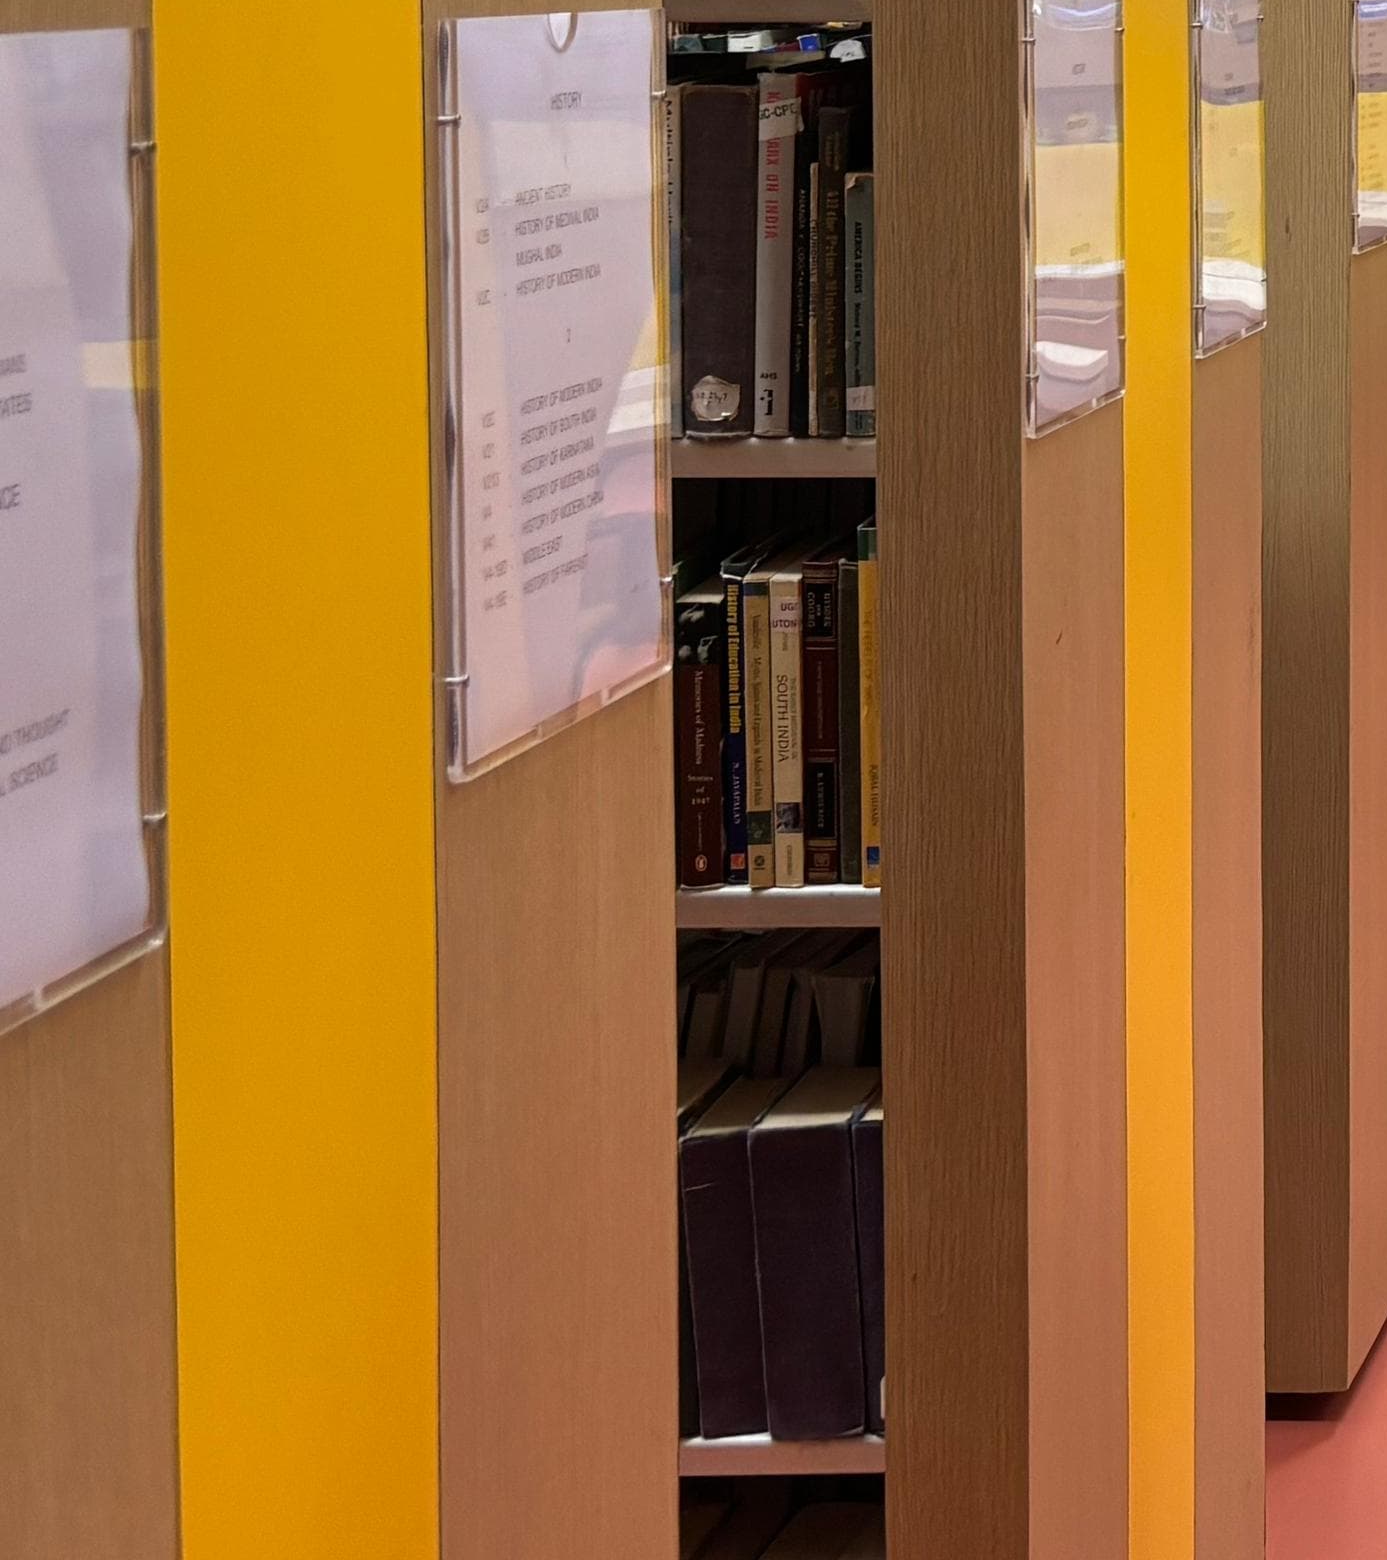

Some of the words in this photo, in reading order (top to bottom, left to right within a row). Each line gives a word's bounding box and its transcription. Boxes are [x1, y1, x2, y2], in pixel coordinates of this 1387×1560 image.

[551, 91, 582, 110] HISTORY
[515, 188, 543, 206] ANCIENT
[544, 183, 571, 201] HISTORY
[515, 218, 544, 236] HISTORY
[545, 214, 554, 232] OF
[583, 206, 600, 222] INDIA
[763, 200, 779, 238] INDIA
[516, 247, 544, 267] MUGHAL
[545, 243, 562, 260] INDIA
[854, 222, 862, 259] AMERICA
[516, 278, 545, 296] HISTORY
[546, 274, 555, 290] OF
[557, 268, 583, 287] MODERN
[584, 264, 601, 280] INDIA
[854, 262, 862, 293] BEGINS
[520, 394, 548, 416] HISTORY
[549, 391, 558, 407] OF
[560, 382, 585, 402] MODERN
[587, 376, 602, 393] INDIA
[520, 424, 548, 445] HISTORY
[549, 420, 558, 437] OF
[560, 412, 580, 432] SOUTH
[581, 406, 597, 424] INDIA
[520, 454, 548, 476] HISTORY
[549, 448, 559, 466] OF
[521, 484, 548, 505] HISTORY
[549, 479, 559, 495] OF
[560, 469, 585, 490] MODERN
[521, 513, 548, 535] HISTORY
[549, 508, 559, 525] OF
[560, 499, 586, 520] MODERN
[586, 491, 604, 509] CHINA
[523, 572, 549, 595] HISTORY
[550, 567, 560, 583] OF
[725, 584, 740, 623] History
[726, 625, 740, 636] of
[726, 637, 741, 691] Education
[776, 674, 788, 720] SOUTH
[16, 708, 71, 743] THOUGHT
[727, 705, 741, 734] India
[776, 725, 788, 762] INDIA
[8, 752, 59, 784] SCIENCE
